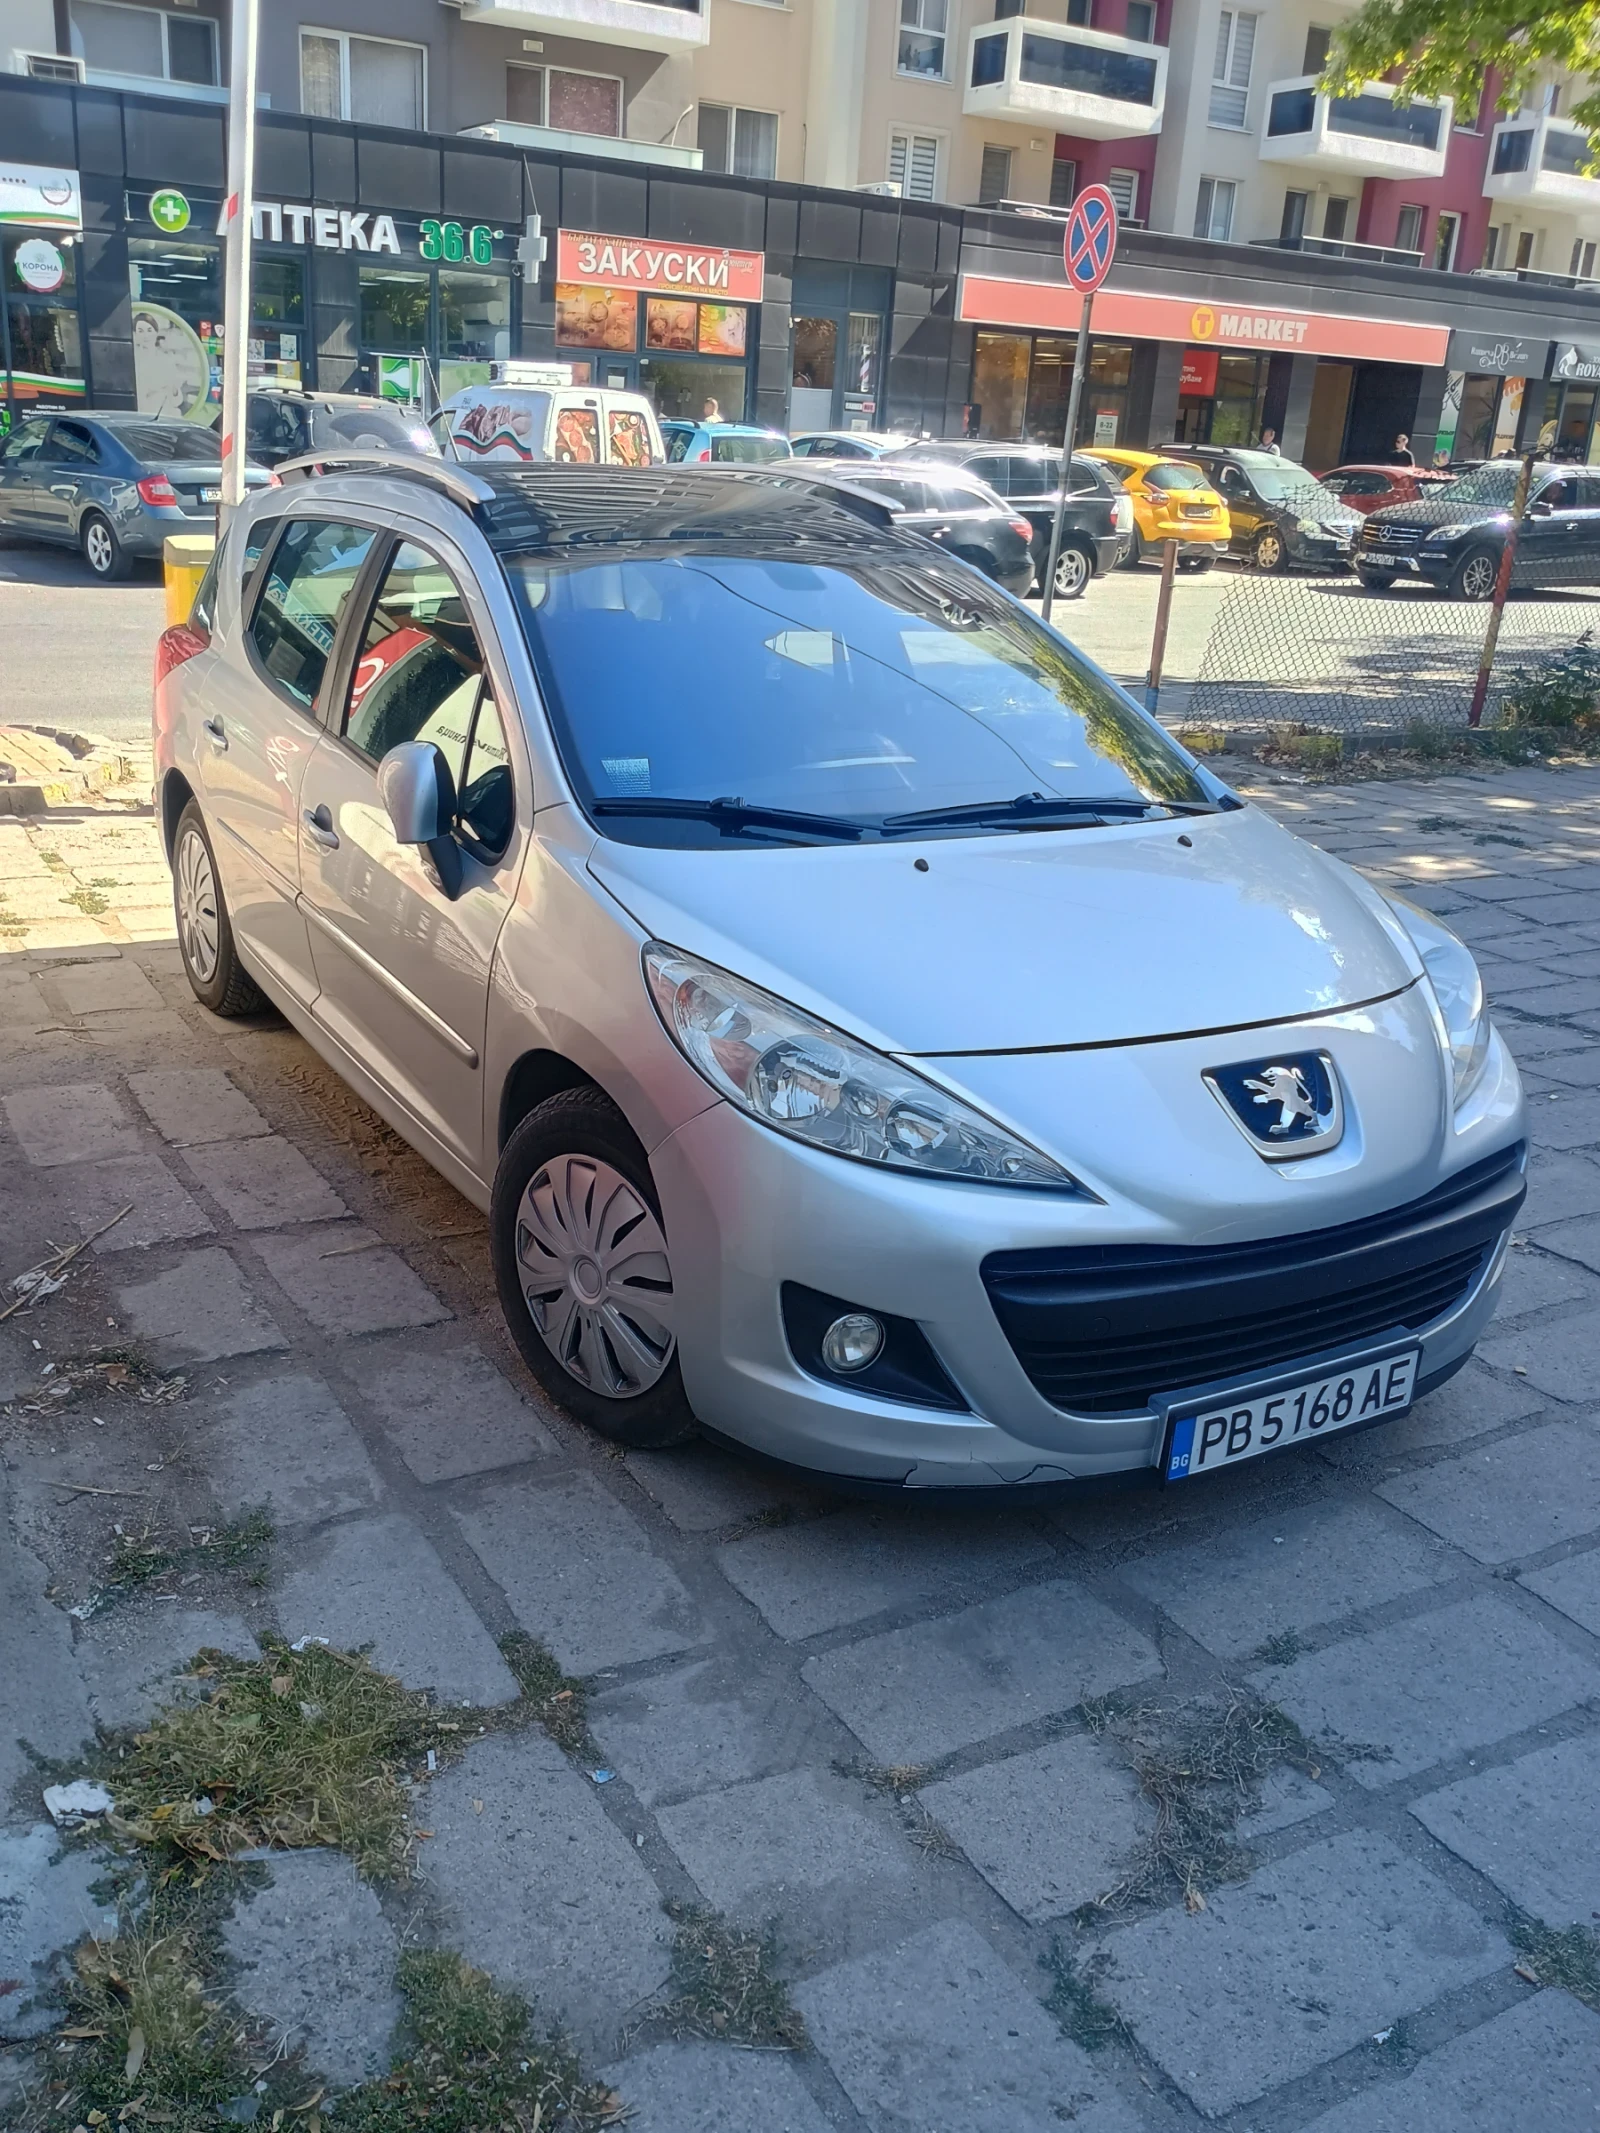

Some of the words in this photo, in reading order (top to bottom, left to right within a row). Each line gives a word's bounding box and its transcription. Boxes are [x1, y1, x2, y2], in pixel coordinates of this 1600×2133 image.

[22, 262, 59, 272] КОРОНА
[578, 241, 730, 289] ЗАКУСКИ
[1218, 314, 1308, 343] MARKET
[1170, 1452, 1190, 1471] BG
